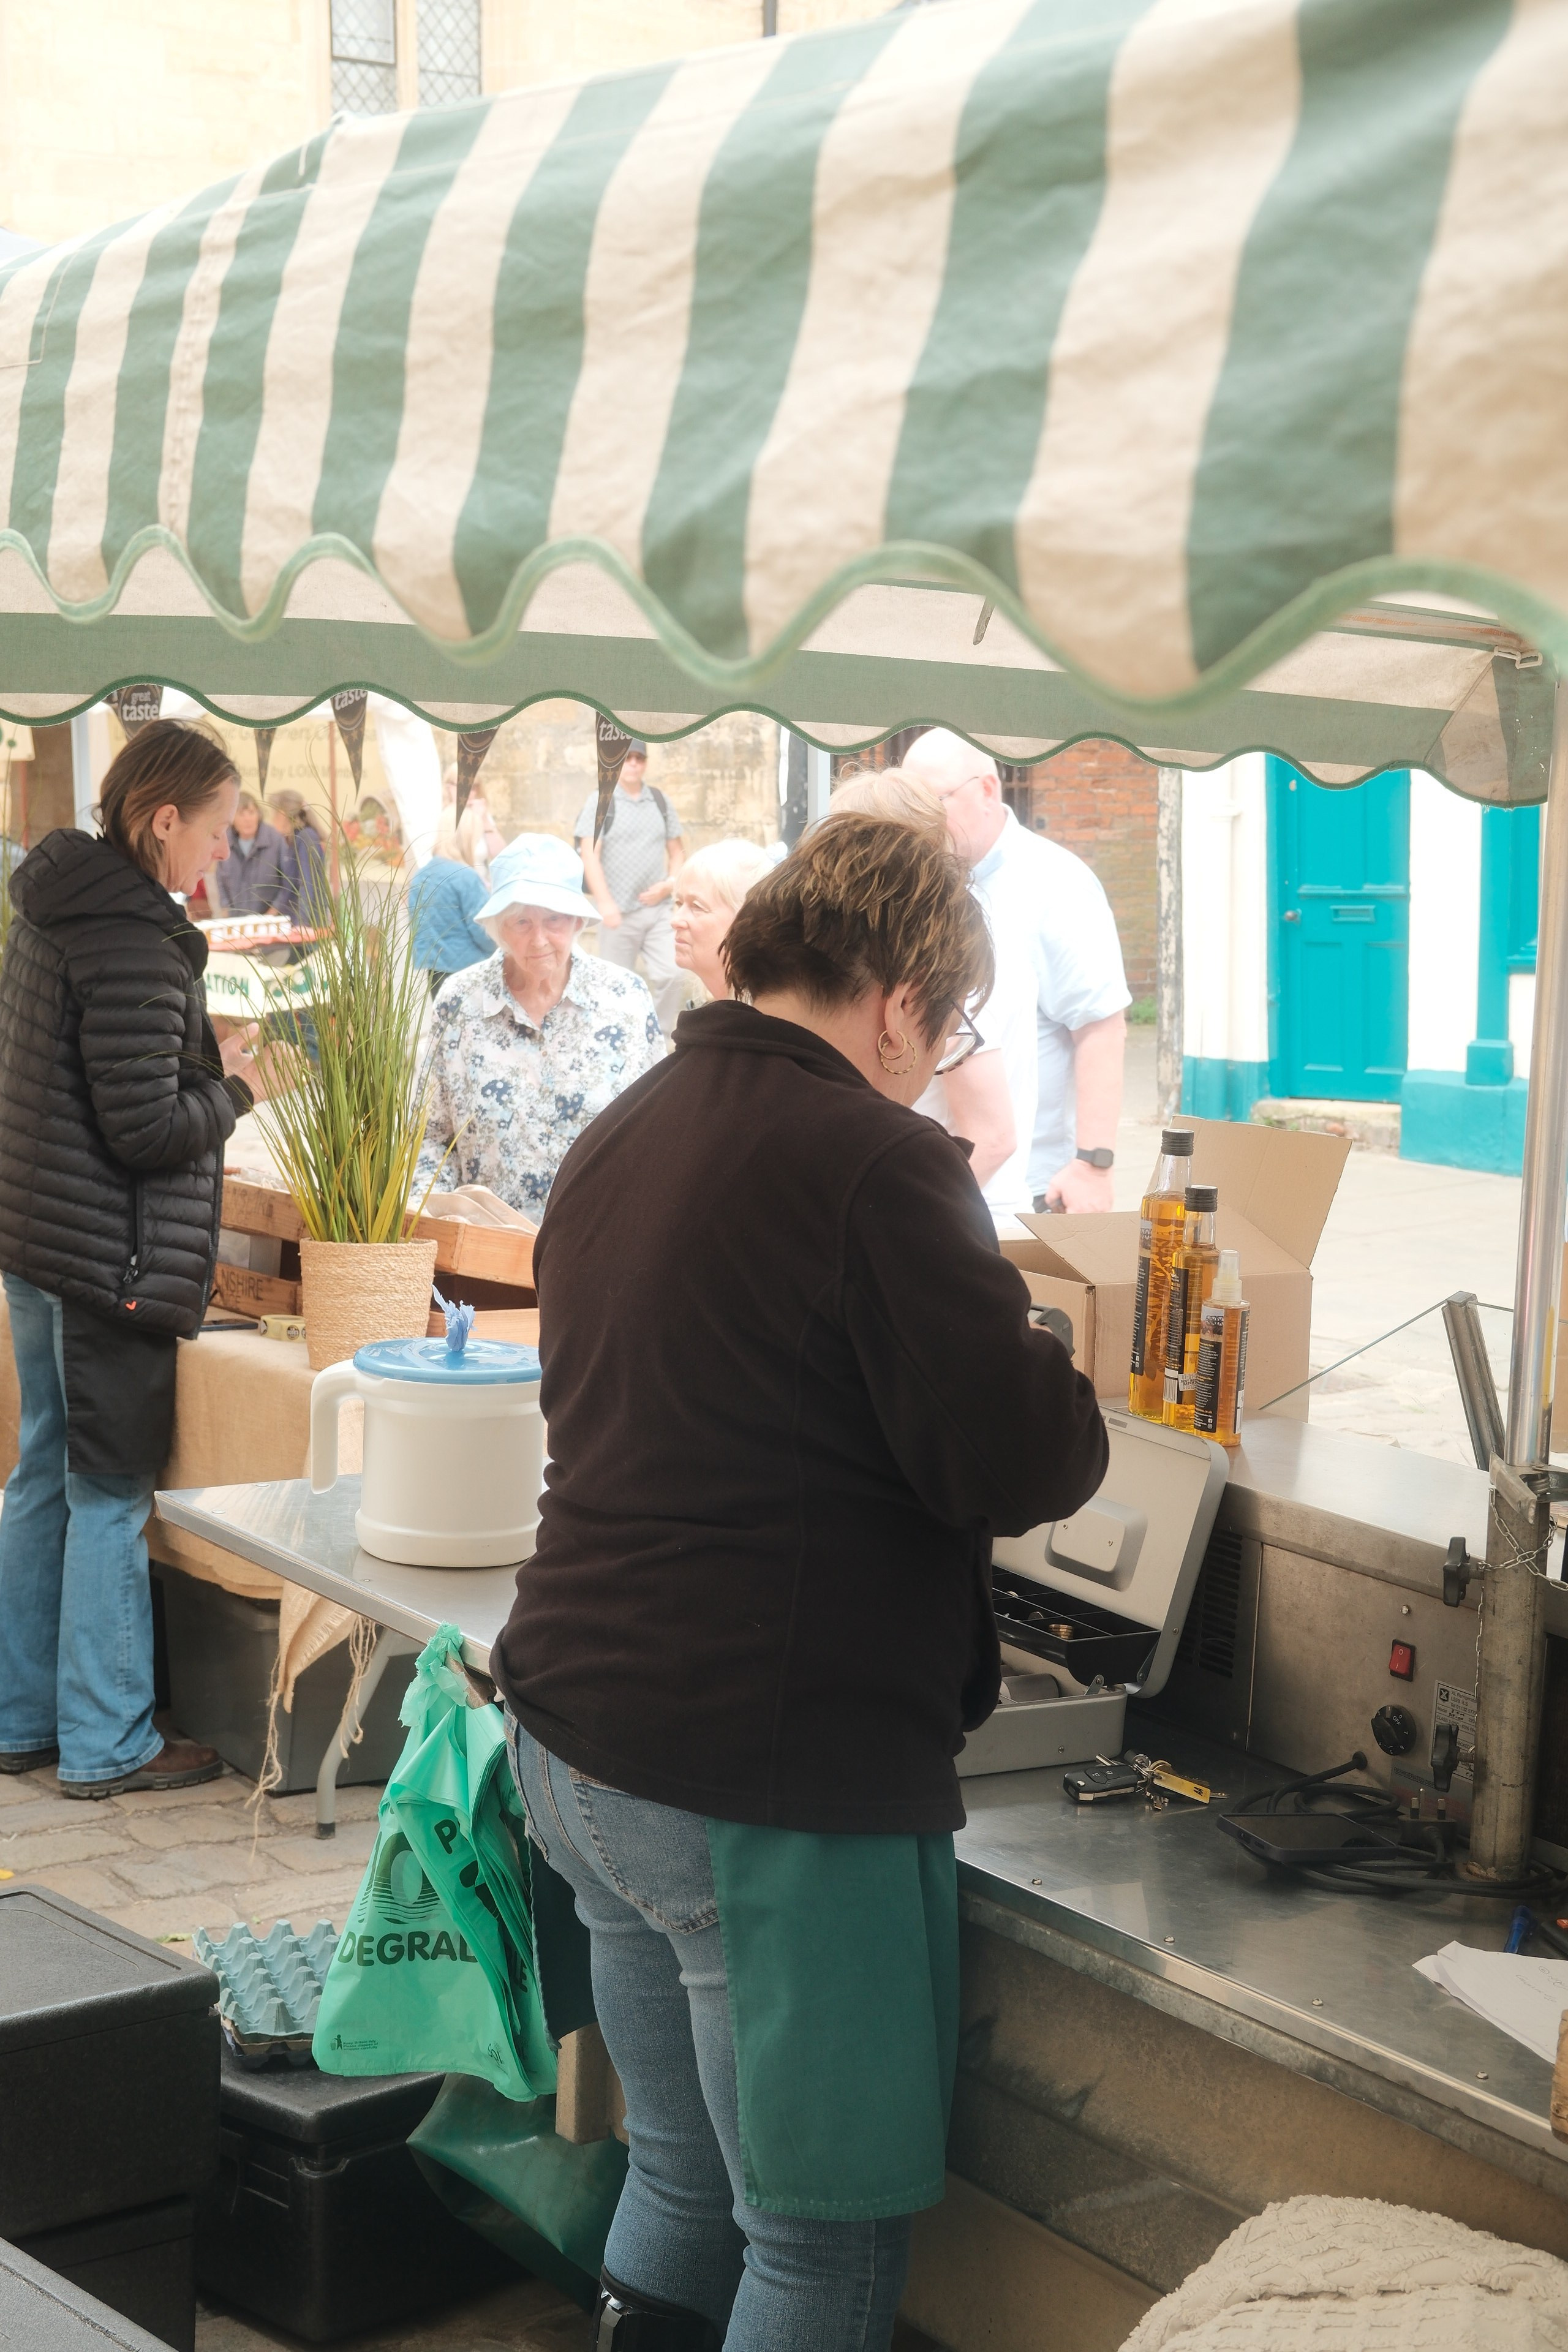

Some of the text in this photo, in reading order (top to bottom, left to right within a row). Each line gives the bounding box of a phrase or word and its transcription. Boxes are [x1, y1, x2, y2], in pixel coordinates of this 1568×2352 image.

[131, 691, 151, 704] great
[123, 703, 159, 721] taste
[599, 721, 631, 741] tas
[221, 1268, 263, 1302] NSHIRE
[1393, 1716, 1401, 1725] OFF
